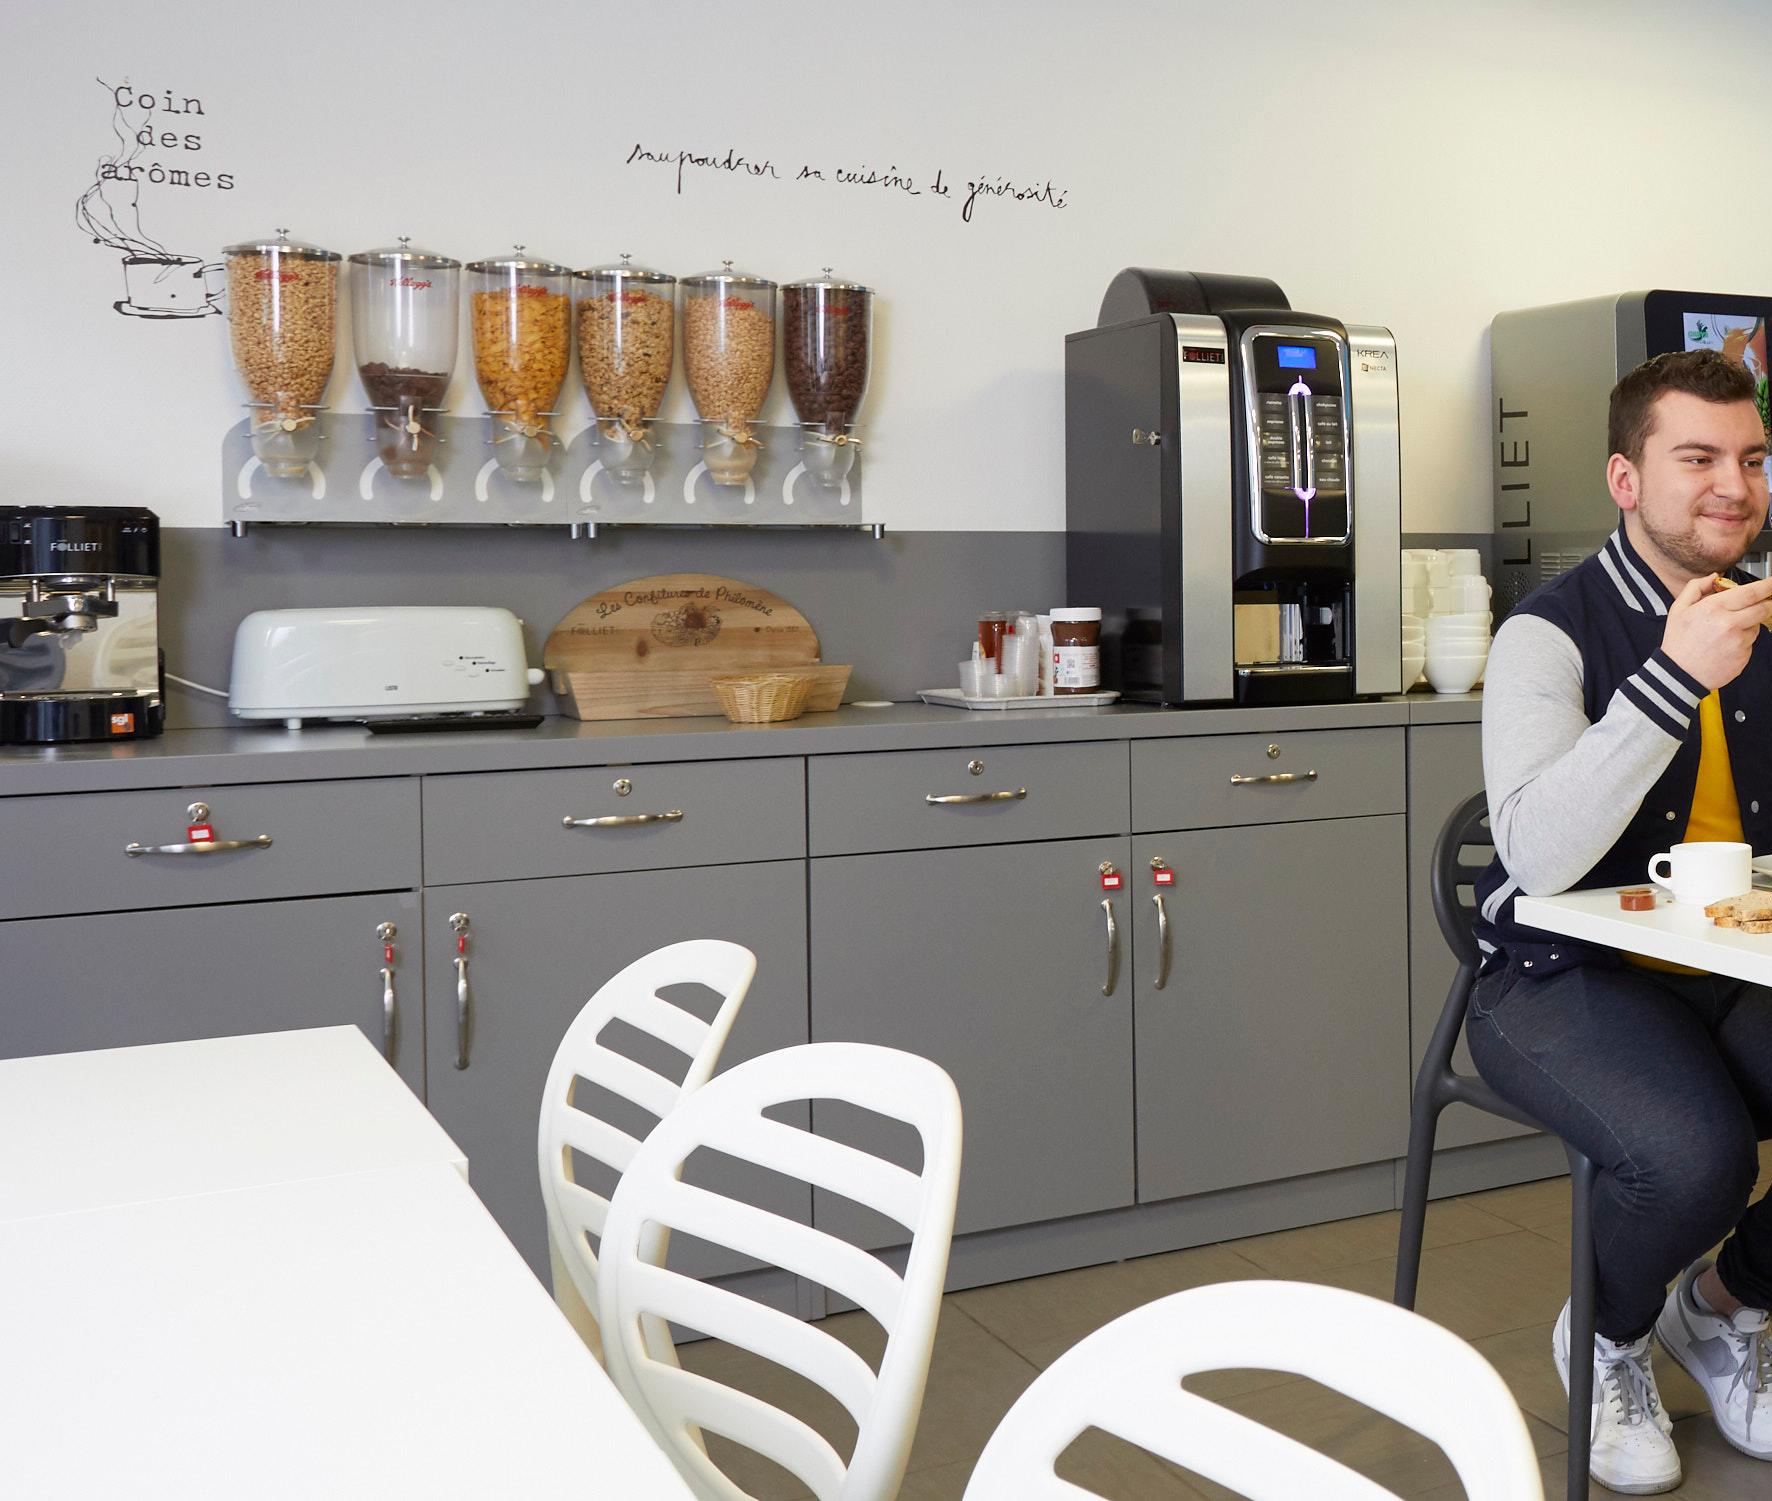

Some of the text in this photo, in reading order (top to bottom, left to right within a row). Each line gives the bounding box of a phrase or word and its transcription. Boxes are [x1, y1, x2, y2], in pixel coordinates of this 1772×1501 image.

[114, 86, 205, 116] Coin
[136, 125, 202, 151] des
[101, 162, 234, 190] arômes
[796, 165, 827, 181] sa
[930, 169, 951, 198] de
[962, 174, 1068, 223] générosité
